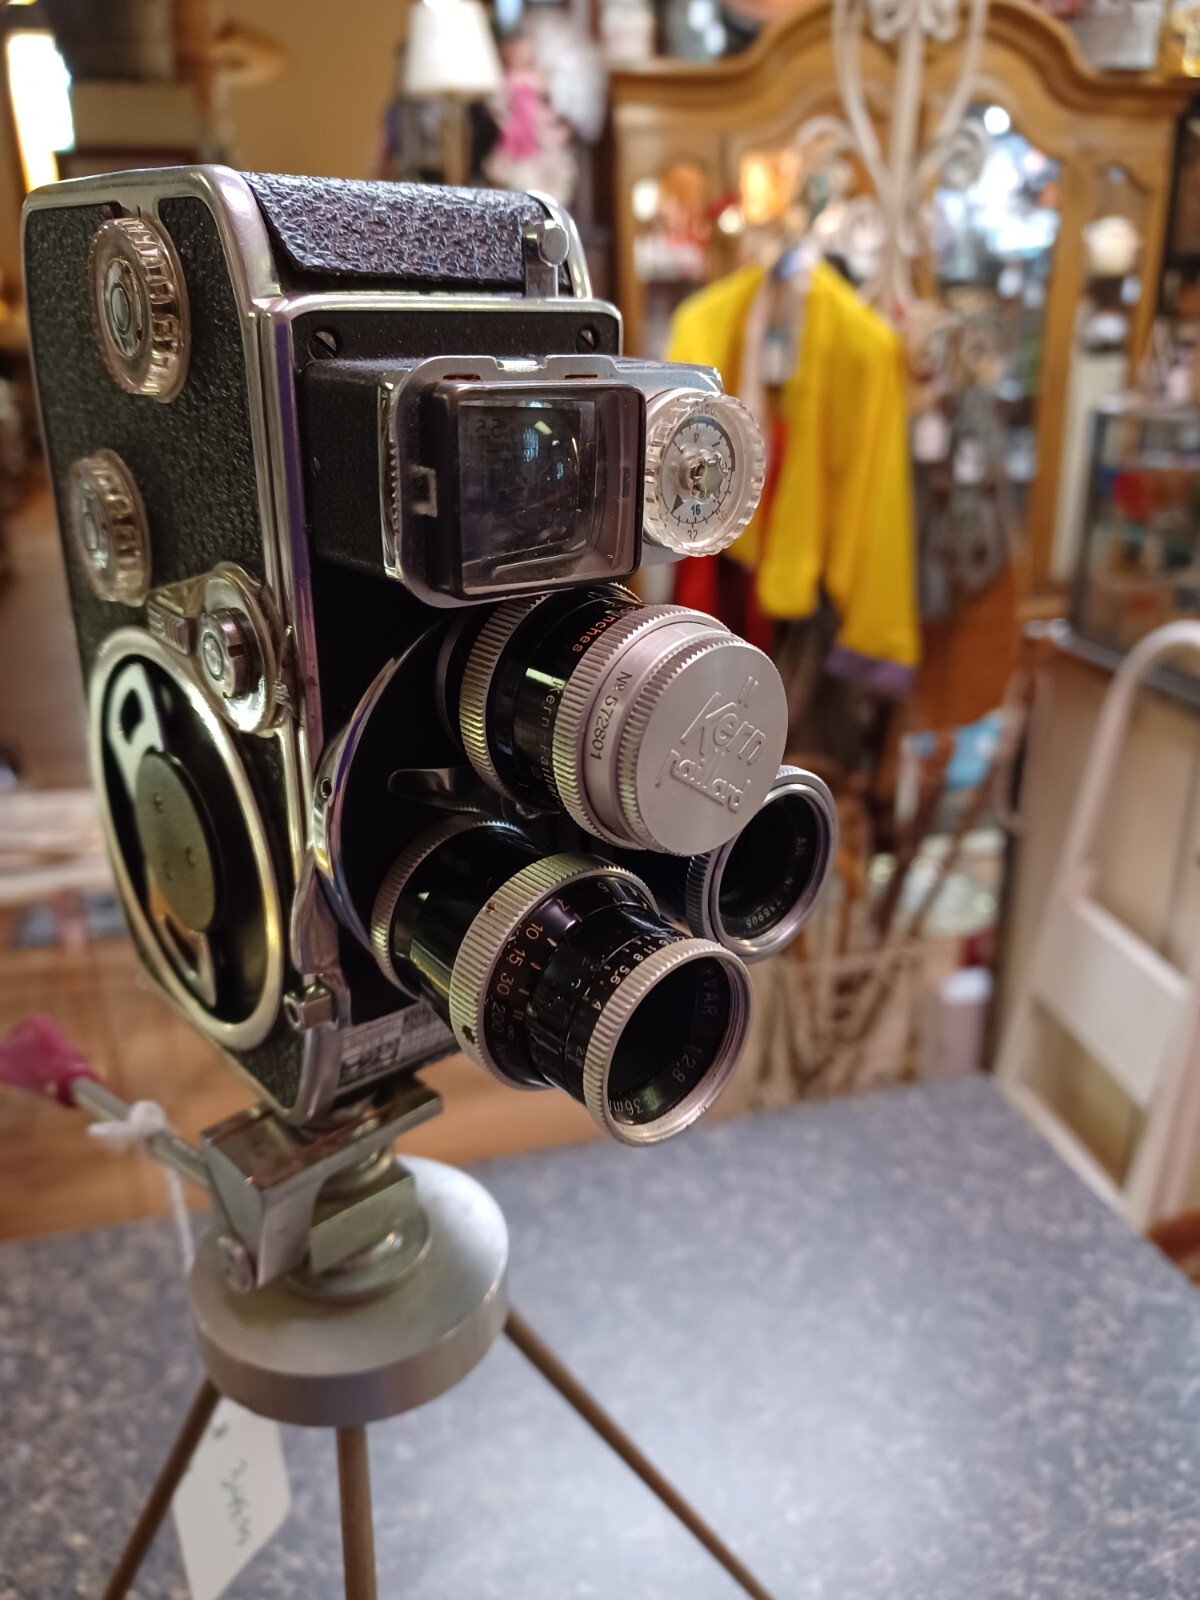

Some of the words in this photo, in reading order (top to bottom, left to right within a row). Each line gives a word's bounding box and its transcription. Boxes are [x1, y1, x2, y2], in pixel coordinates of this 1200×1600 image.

[690, 504, 702, 516] 16
[590, 695, 618, 760] 572801
[680, 691, 767, 766] Kern
[525, 921, 543, 941] 10
[508, 948, 527, 968] 15
[496, 972, 515, 996] 30
[609, 964, 631, 985] 5.6
[591, 999, 602, 1011] 4
